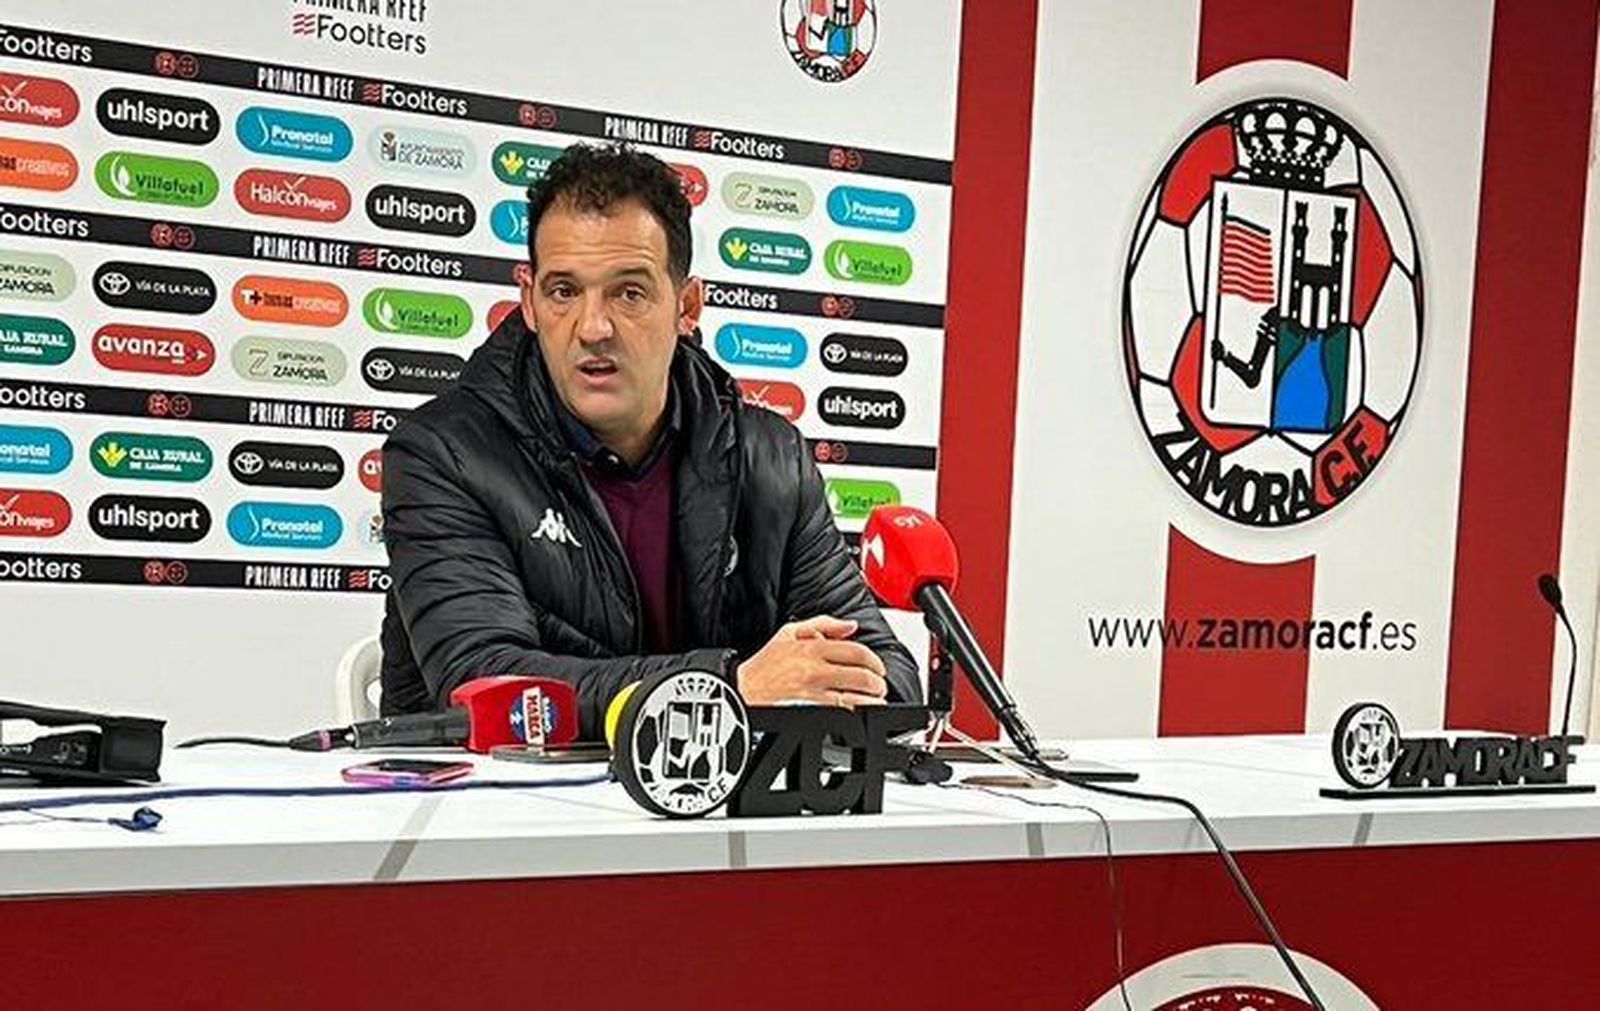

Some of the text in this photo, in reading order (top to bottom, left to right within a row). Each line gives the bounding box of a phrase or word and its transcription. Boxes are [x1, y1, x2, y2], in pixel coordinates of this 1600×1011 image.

[317, 13, 427, 54] Footters
[257, 66, 468, 117] PRIMERA RFEF Footters
[107, 100, 210, 131] uhlsport
[271, 124, 334, 145] Pronatal
[604, 116, 784, 160] PRIMERA RFEF Footters
[527, 156, 551, 169] CAJ
[135, 174, 205, 196] Villafuel
[0, 205, 90, 237] ootters
[375, 194, 466, 225] uhlsport
[253, 235, 463, 277] PRIMERA RFEF Footters
[152, 283, 167, 293] DE
[169, 284, 181, 294] LA
[182, 285, 211, 297] PLATA
[705, 284, 778, 309] Footters
[98, 334, 186, 358] avanza
[273, 364, 329, 380] ZAMORA
[440, 369, 461, 380] PLAT
[0, 386, 86, 409] ootters
[824, 395, 898, 420] uhlsport
[249, 401, 312, 426] PRIMERA
[315, 407, 345, 428] RFEF
[0, 443, 51, 457] onatal
[1151, 410, 1318, 526] ZAMORA
[98, 503, 200, 532] uhlsport
[0, 557, 82, 579] ootters
[245, 565, 341, 589] PRIMERA RFEF
[1088, 610, 1417, 651] www.zamoracf.es
